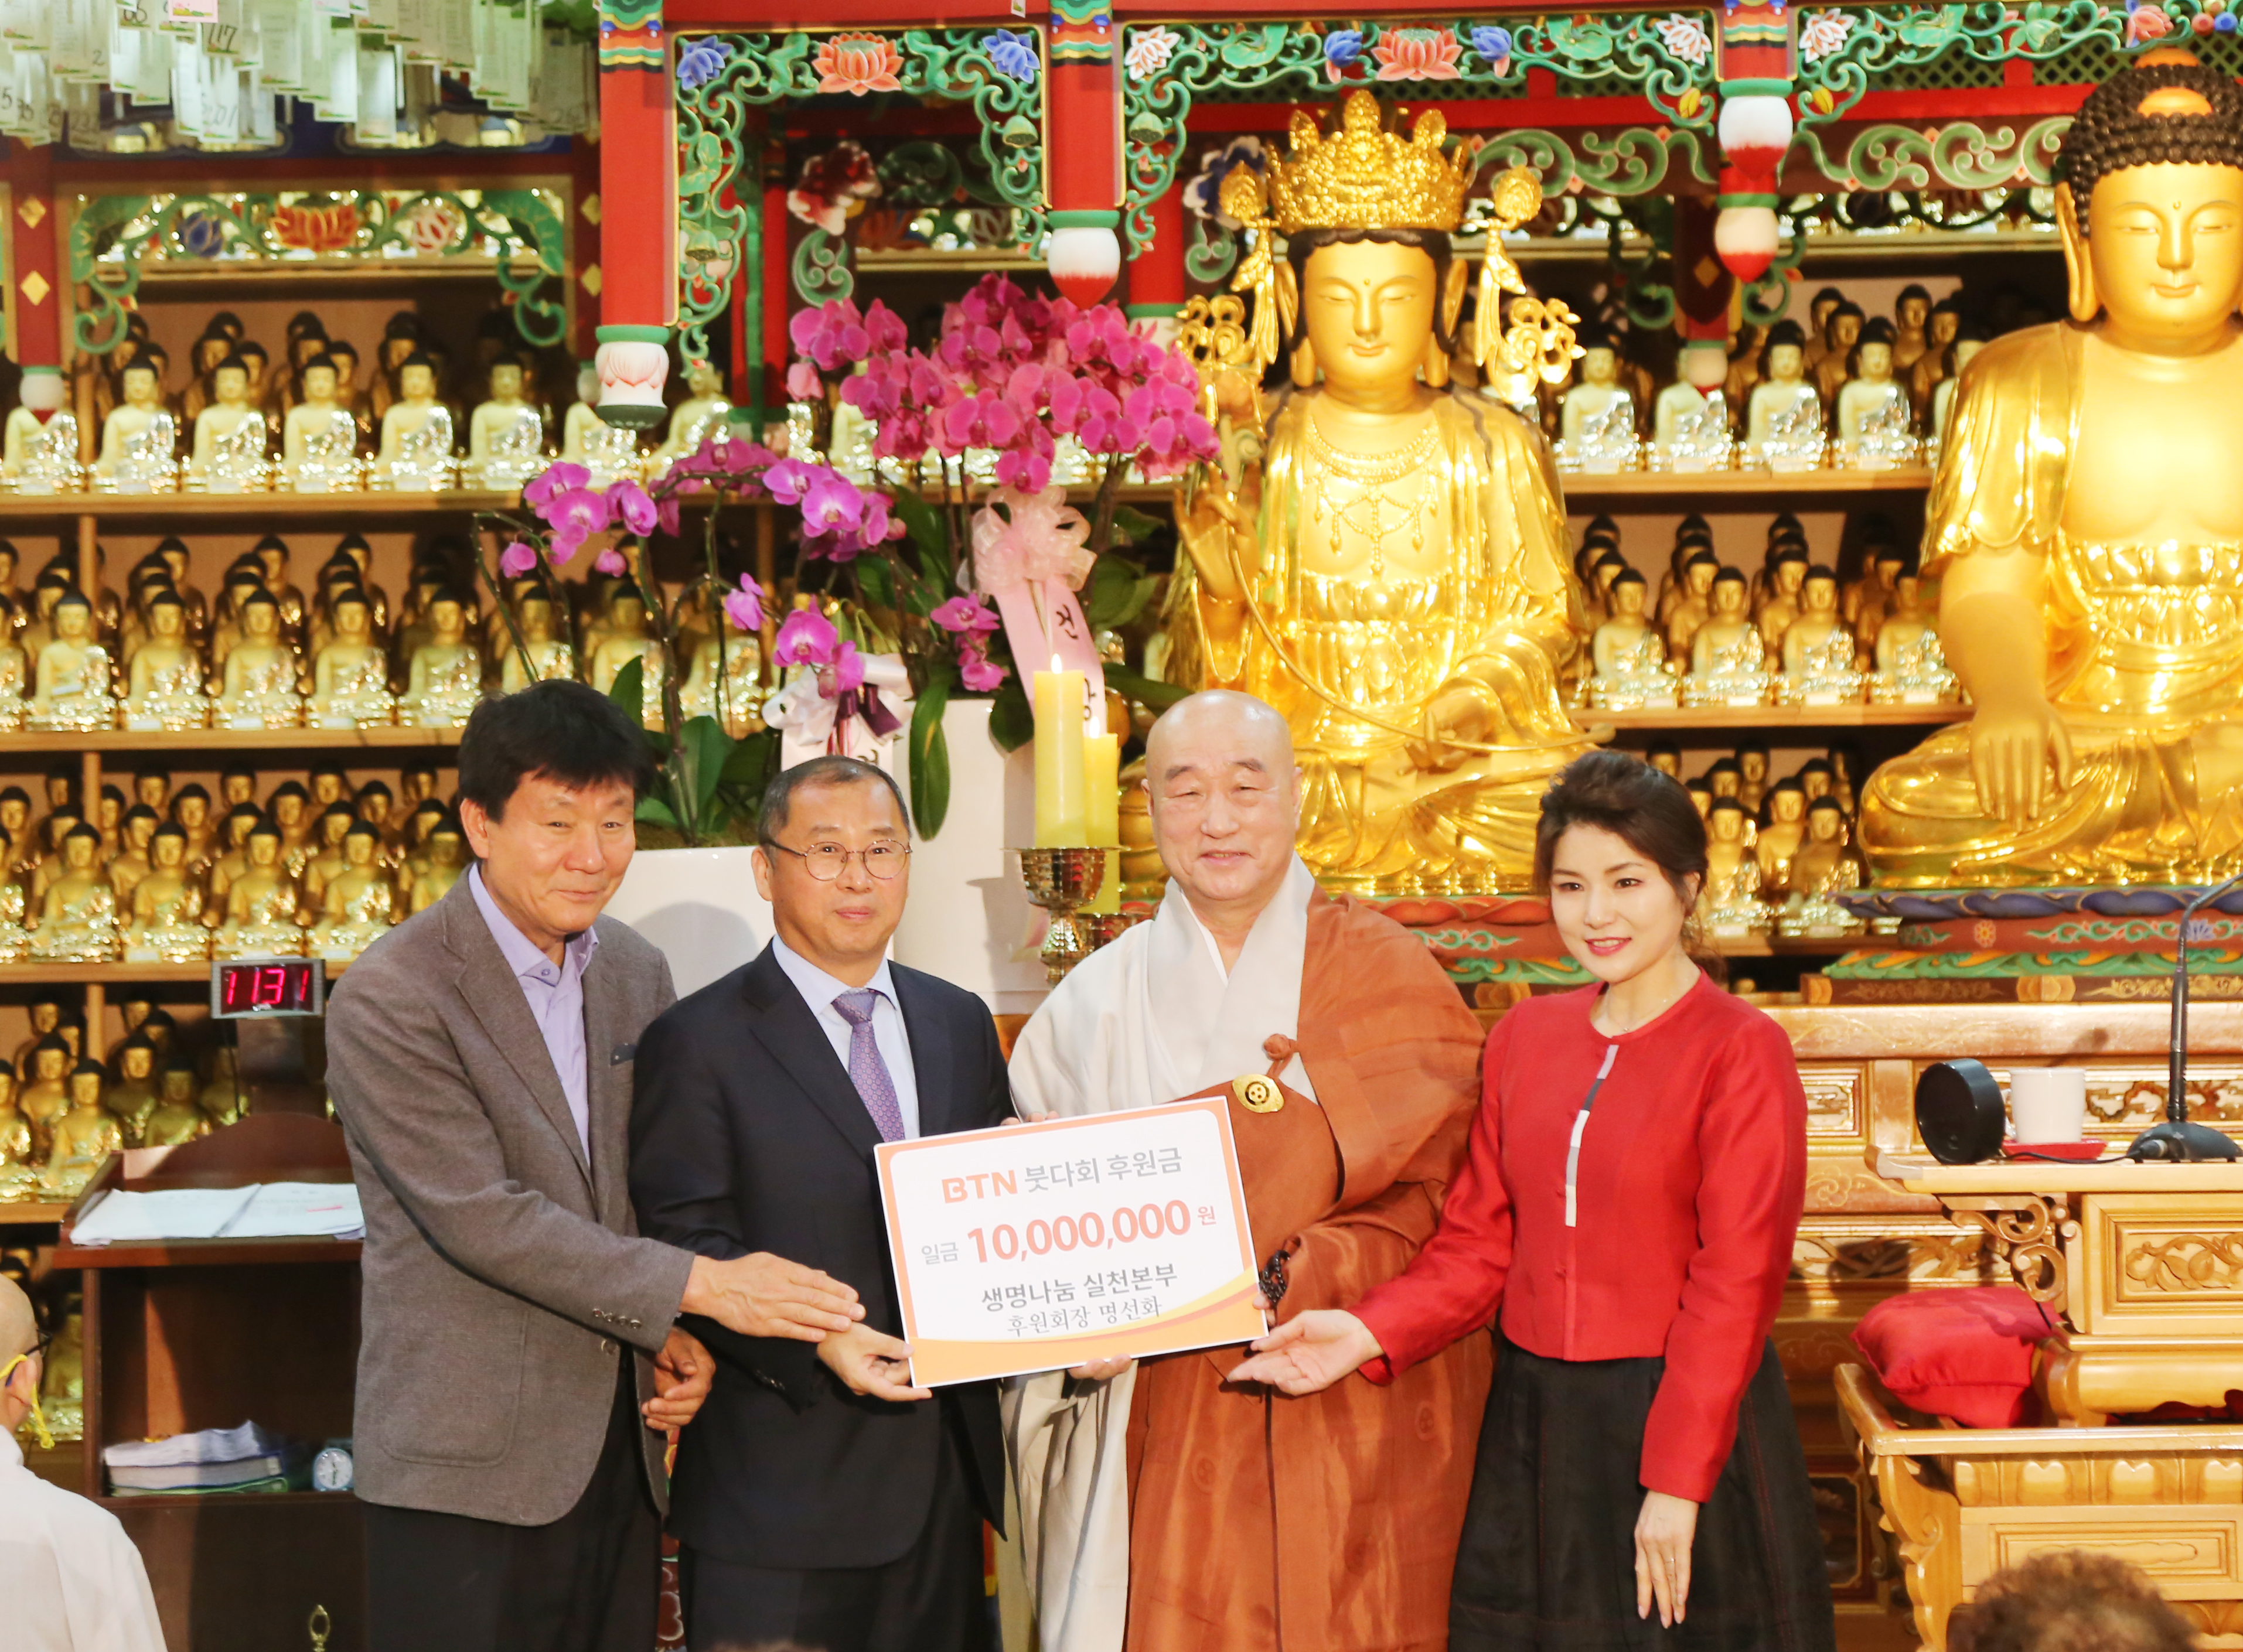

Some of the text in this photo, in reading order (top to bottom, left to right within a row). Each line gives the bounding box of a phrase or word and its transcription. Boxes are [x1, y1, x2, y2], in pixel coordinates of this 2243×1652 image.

[942, 1147, 1182, 1203] BTN 붓다회 후원금
[922, 1200, 1216, 1265] 일금 10,000,000 원
[981, 1264, 1177, 1312] 생명나눔 실천본부
[1008, 1296, 1162, 1337] 후원회장 명선화
